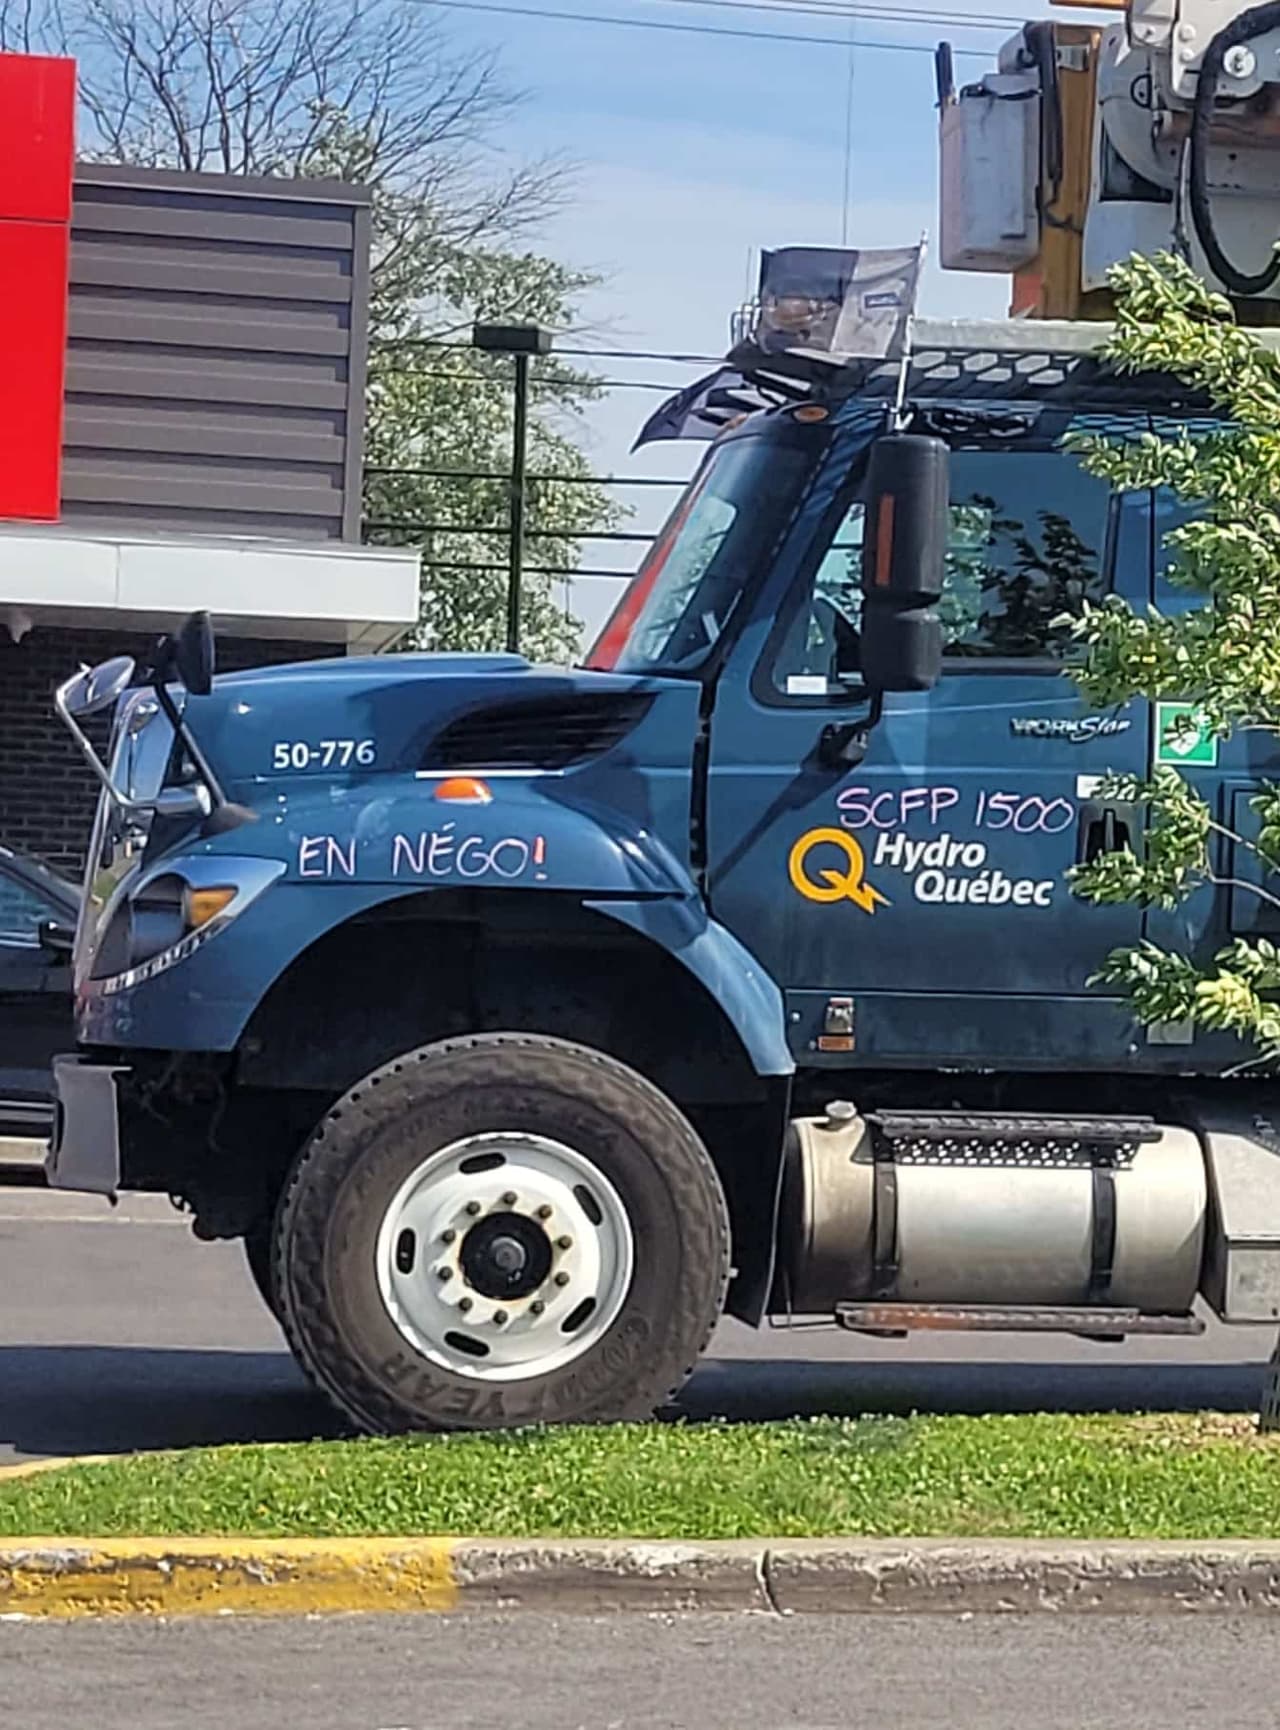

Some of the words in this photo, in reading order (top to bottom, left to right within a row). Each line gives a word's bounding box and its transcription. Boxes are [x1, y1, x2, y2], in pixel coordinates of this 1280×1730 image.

[273, 740, 376, 769] 50-776
[836, 787, 959, 828] SCFP
[976, 791, 1074, 832] 1500
[299, 834, 357, 878] EN
[391, 823, 548, 880] NÉGO!
[873, 832, 986, 872] Hydro
[915, 870, 1054, 906] Québec
